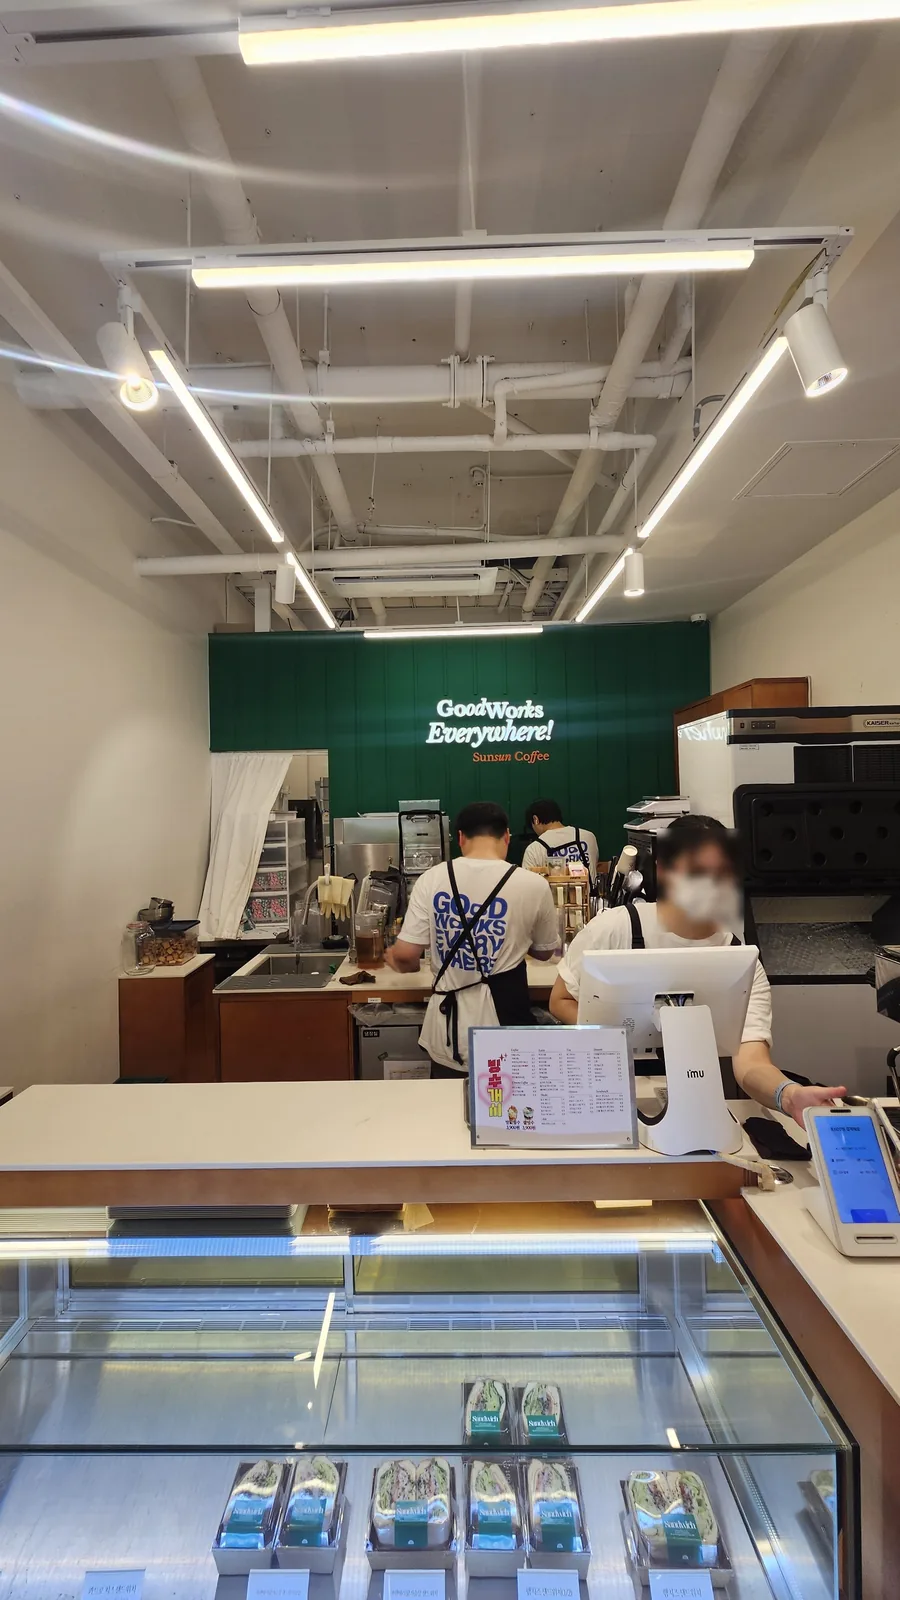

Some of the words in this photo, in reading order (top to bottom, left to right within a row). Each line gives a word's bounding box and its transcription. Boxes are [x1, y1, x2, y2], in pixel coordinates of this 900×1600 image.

[425, 719, 554, 748] Everywhere!
[473, 752, 511, 762] Sunsun
[514, 751, 550, 763] Coffee
[548, 841, 588, 857] OOD
[472, 1415, 499, 1423] Sandwich
[664, 1520, 697, 1530] Sandwich
